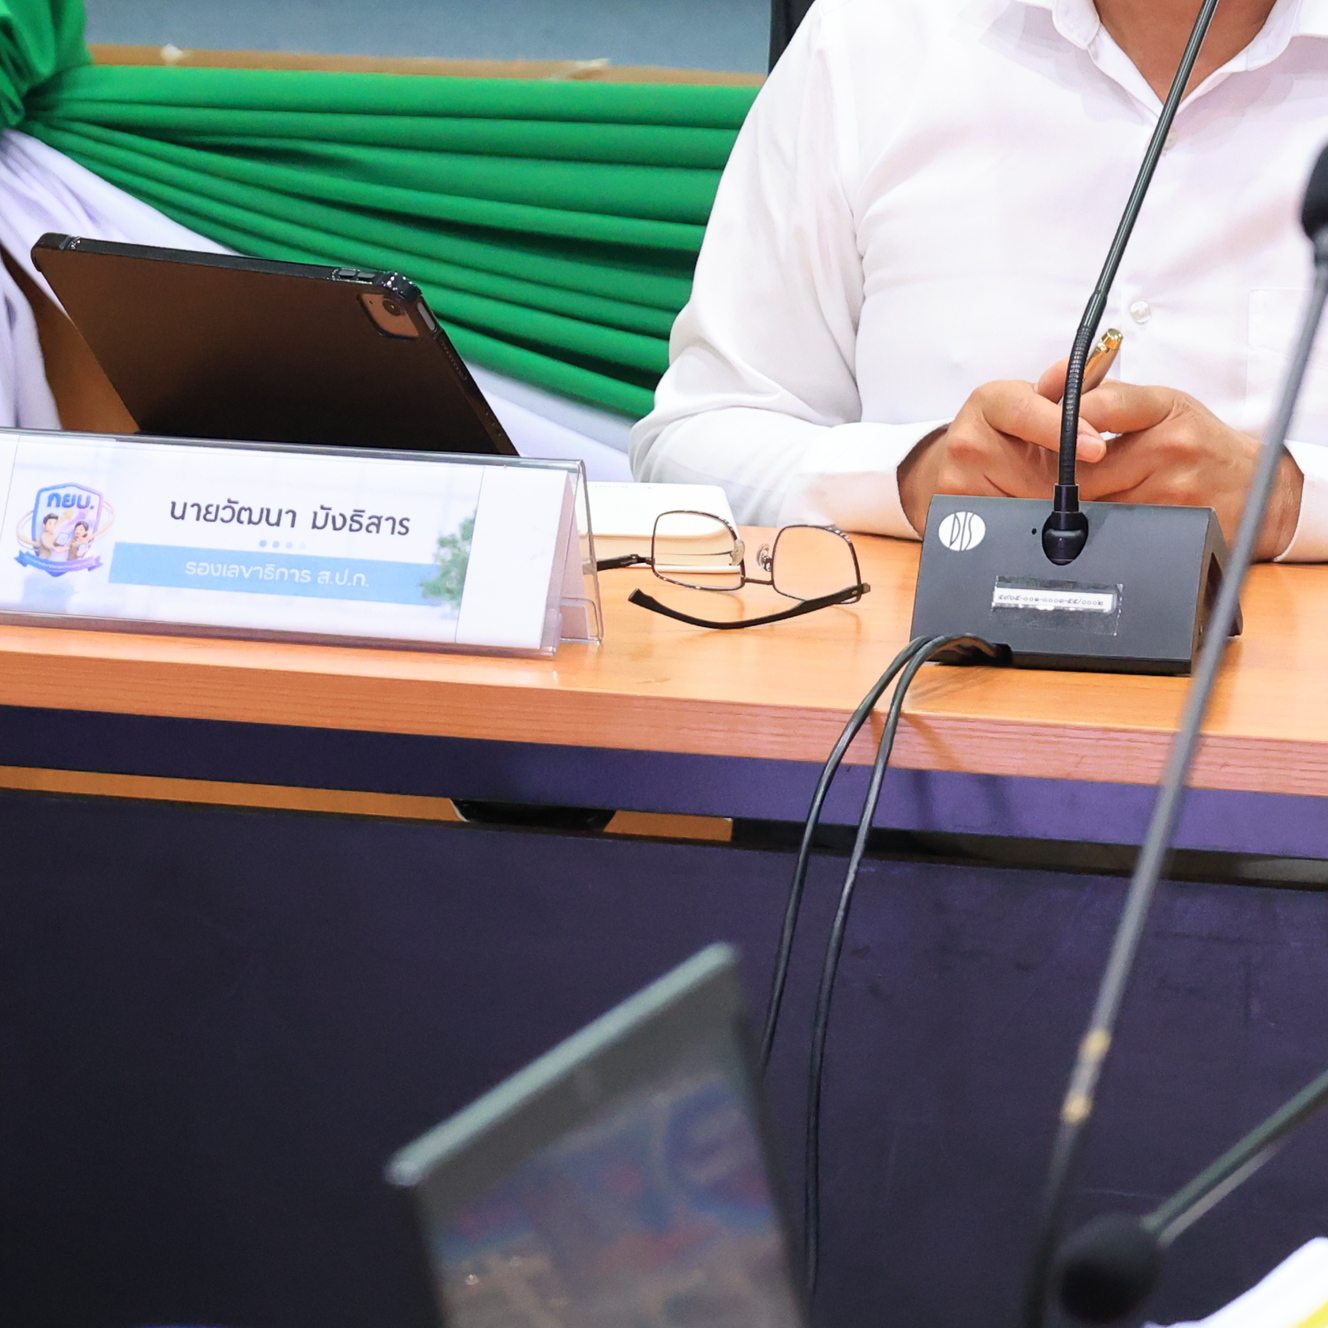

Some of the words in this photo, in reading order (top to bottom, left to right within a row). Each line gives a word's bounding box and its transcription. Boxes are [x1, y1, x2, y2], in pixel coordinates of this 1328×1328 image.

[169, 498, 297, 528] นายวัฒนา
[311, 504, 411, 536] มังธิสาร
[184, 561, 311, 584] รองเลขาธิการ
[317, 569, 370, 588] ส.ป.ก.
